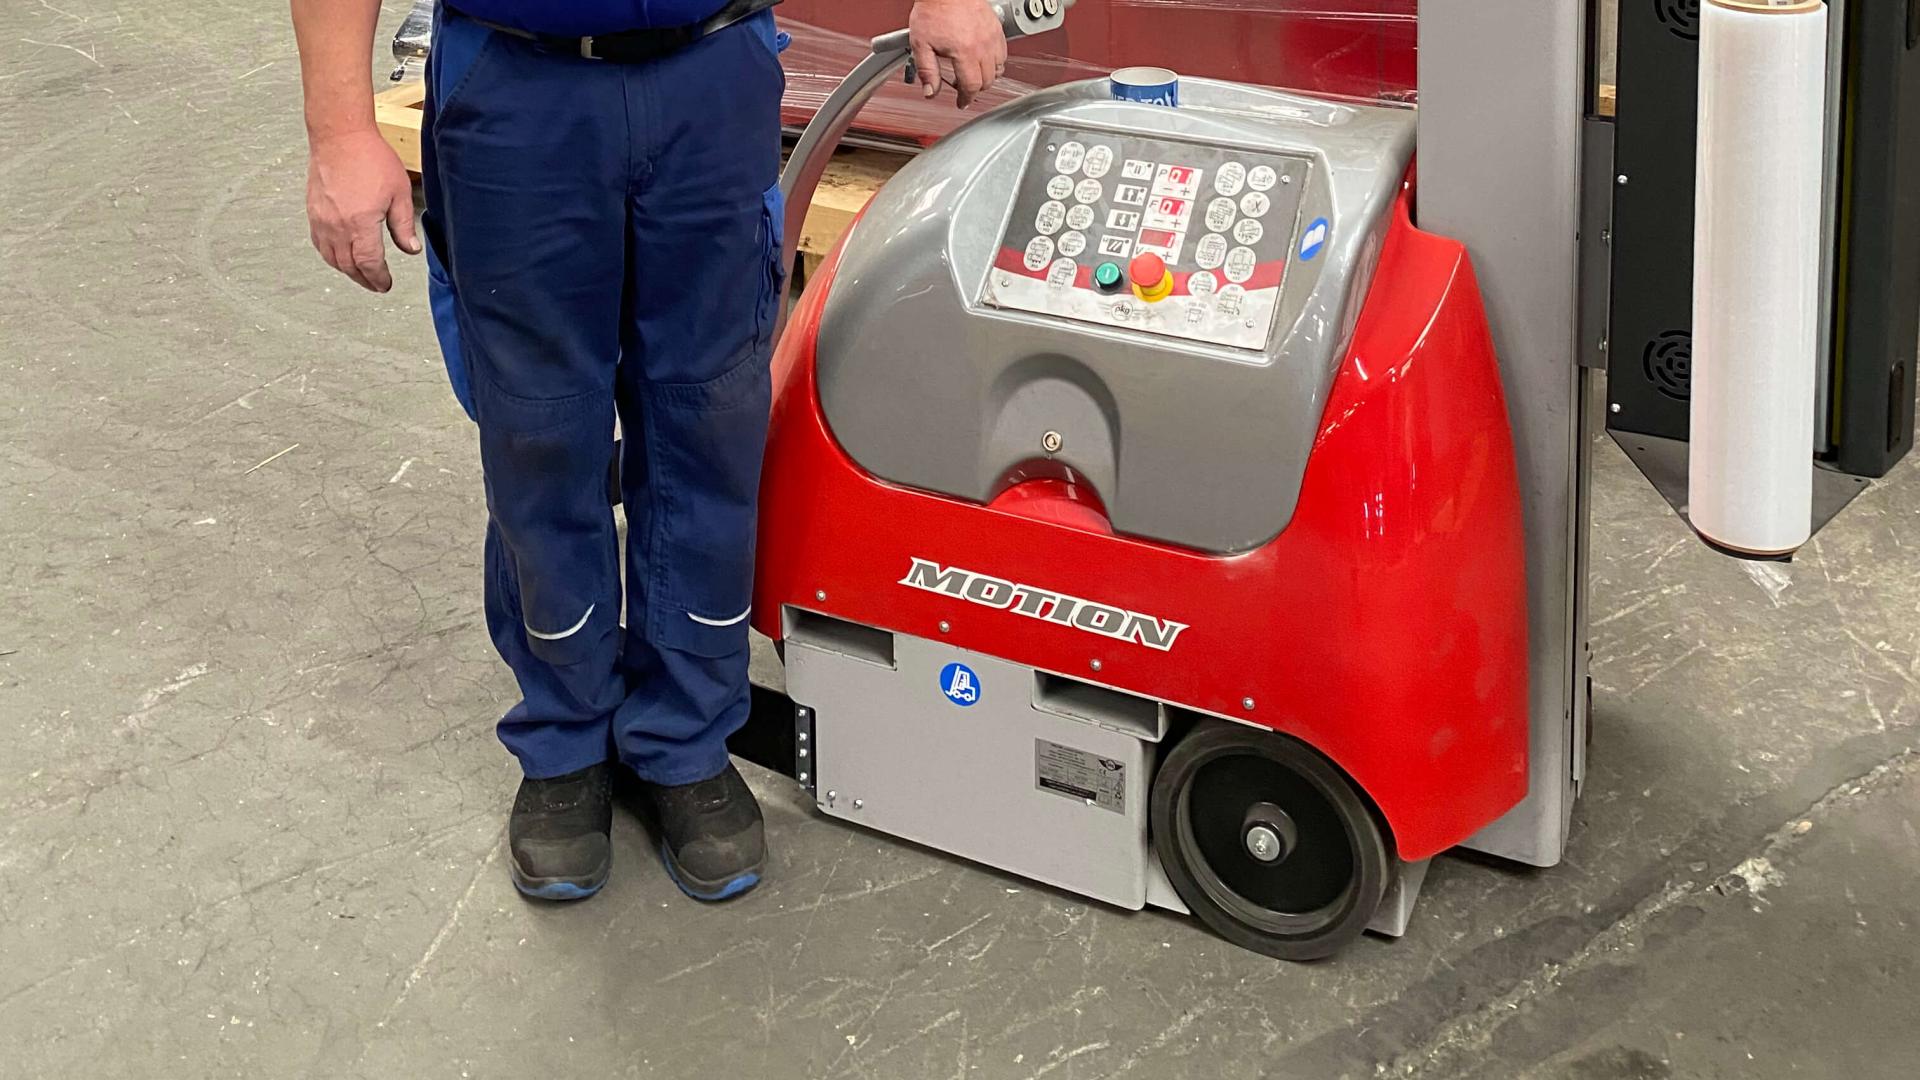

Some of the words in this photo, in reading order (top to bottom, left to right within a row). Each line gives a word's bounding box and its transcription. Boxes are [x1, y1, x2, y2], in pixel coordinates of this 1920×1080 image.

[1159, 169, 1168, 177] P
[1149, 200, 1159, 208] F
[897, 557, 1190, 651] MOTION
